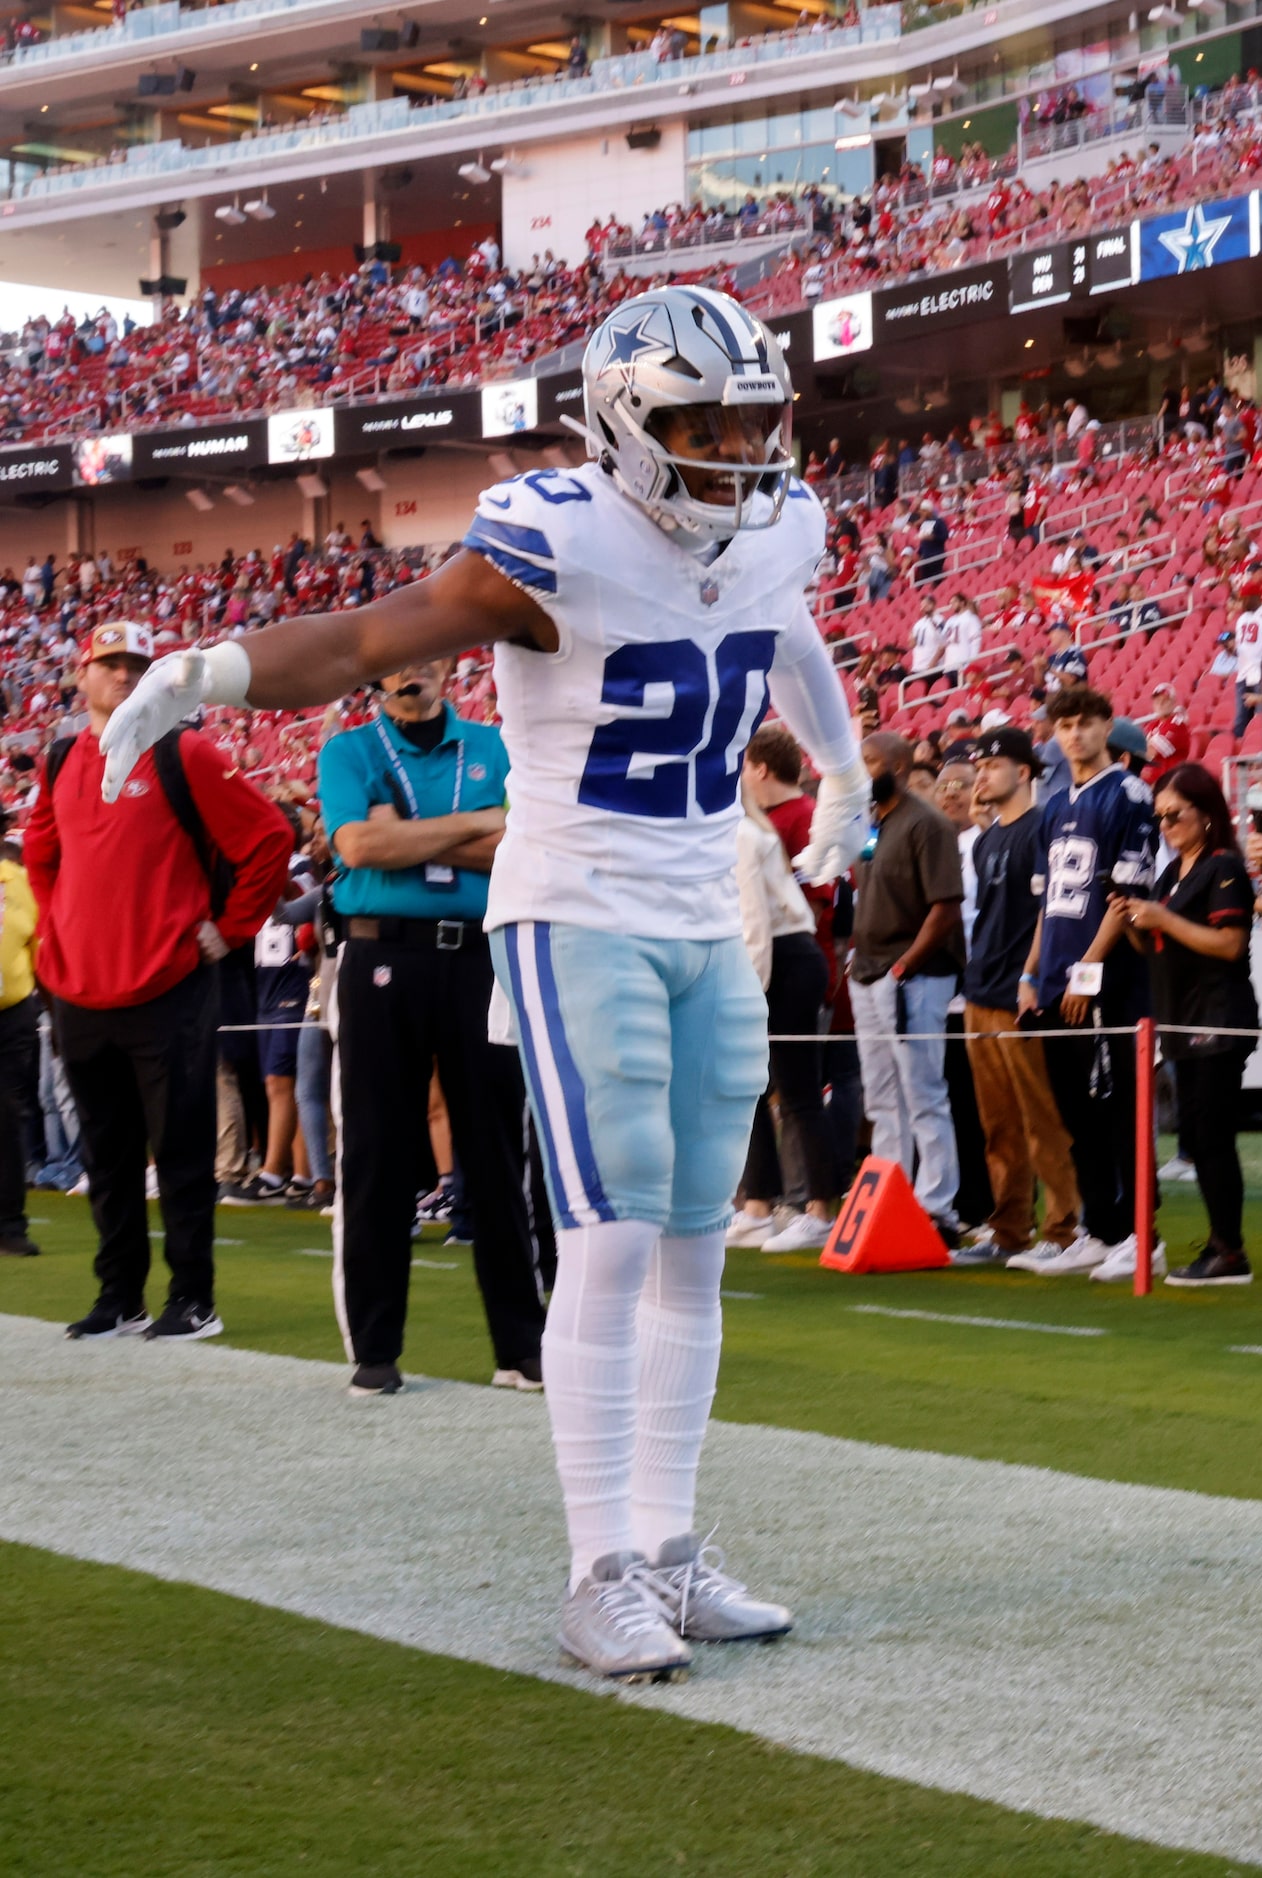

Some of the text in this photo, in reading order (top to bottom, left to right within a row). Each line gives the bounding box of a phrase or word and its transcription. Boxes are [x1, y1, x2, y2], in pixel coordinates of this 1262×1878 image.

[920, 280, 994, 317] ELECTRIC
[737, 381, 776, 391] COWBOYS
[401, 410, 453, 430] LEXUS
[187, 435, 248, 458] HUMAN
[0, 459, 59, 480] LECTRIC
[577, 629, 779, 819] 20
[833, 1170, 881, 1255] G
